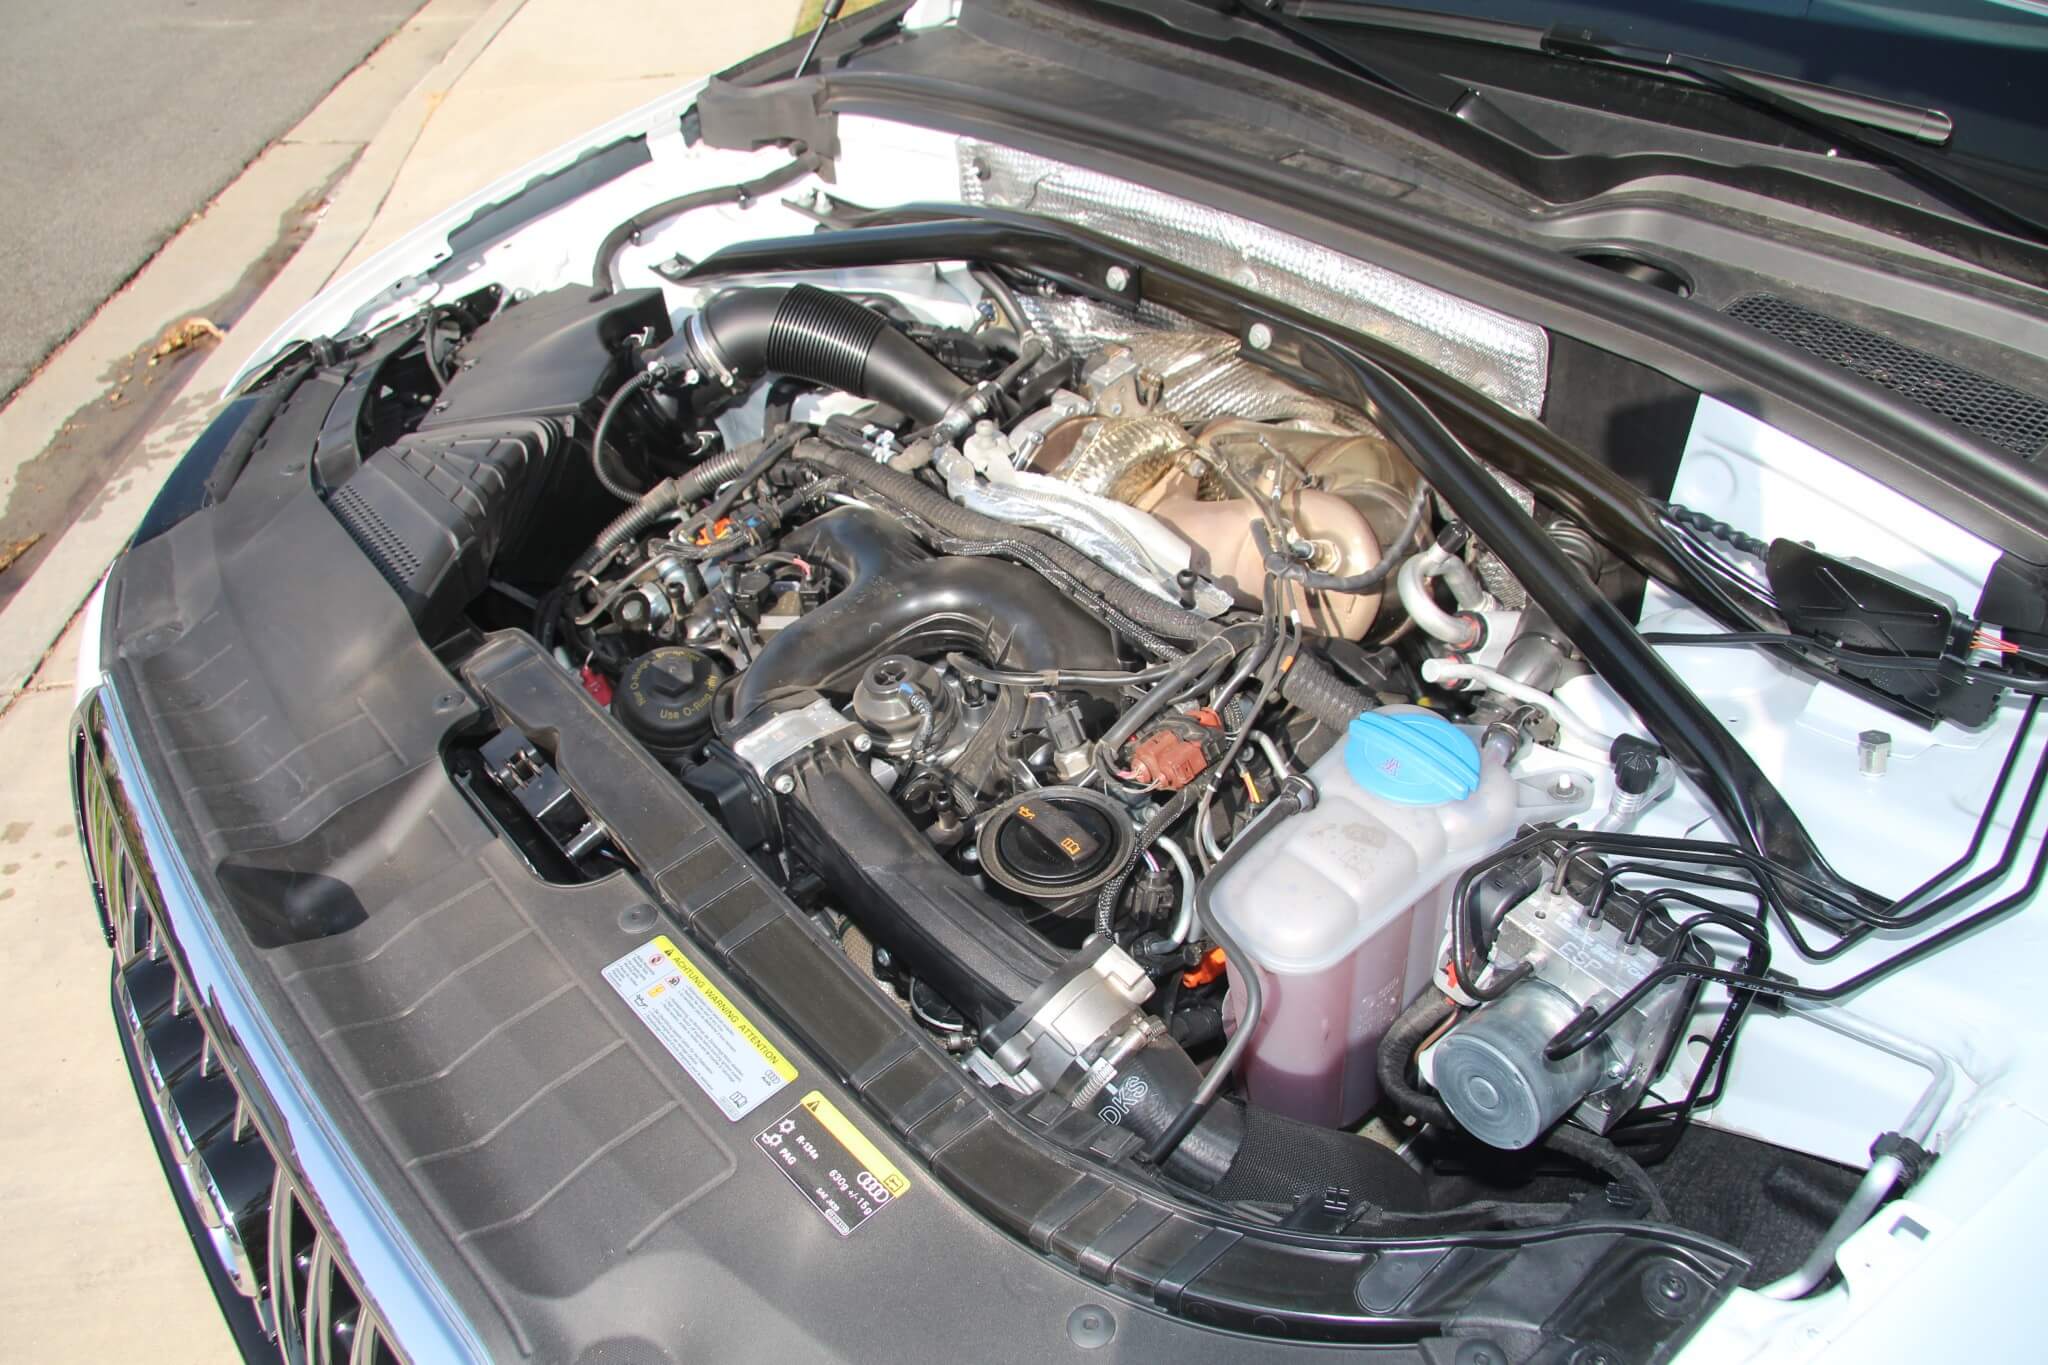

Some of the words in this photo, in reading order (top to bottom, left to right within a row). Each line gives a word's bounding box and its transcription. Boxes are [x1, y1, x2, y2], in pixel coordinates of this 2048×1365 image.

[660, 708, 680, 720] Use
[1559, 942, 1602, 969] ESP
[673, 956, 706, 989] ACHTUNG
[705, 988, 739, 1023] WARNING
[738, 1024, 779, 1064] ATTENTION
[1098, 1075, 1148, 1126] DKS
[779, 1147, 797, 1166] PAG
[796, 1135, 819, 1159] R-134a
[829, 1169, 849, 1191] 630g
